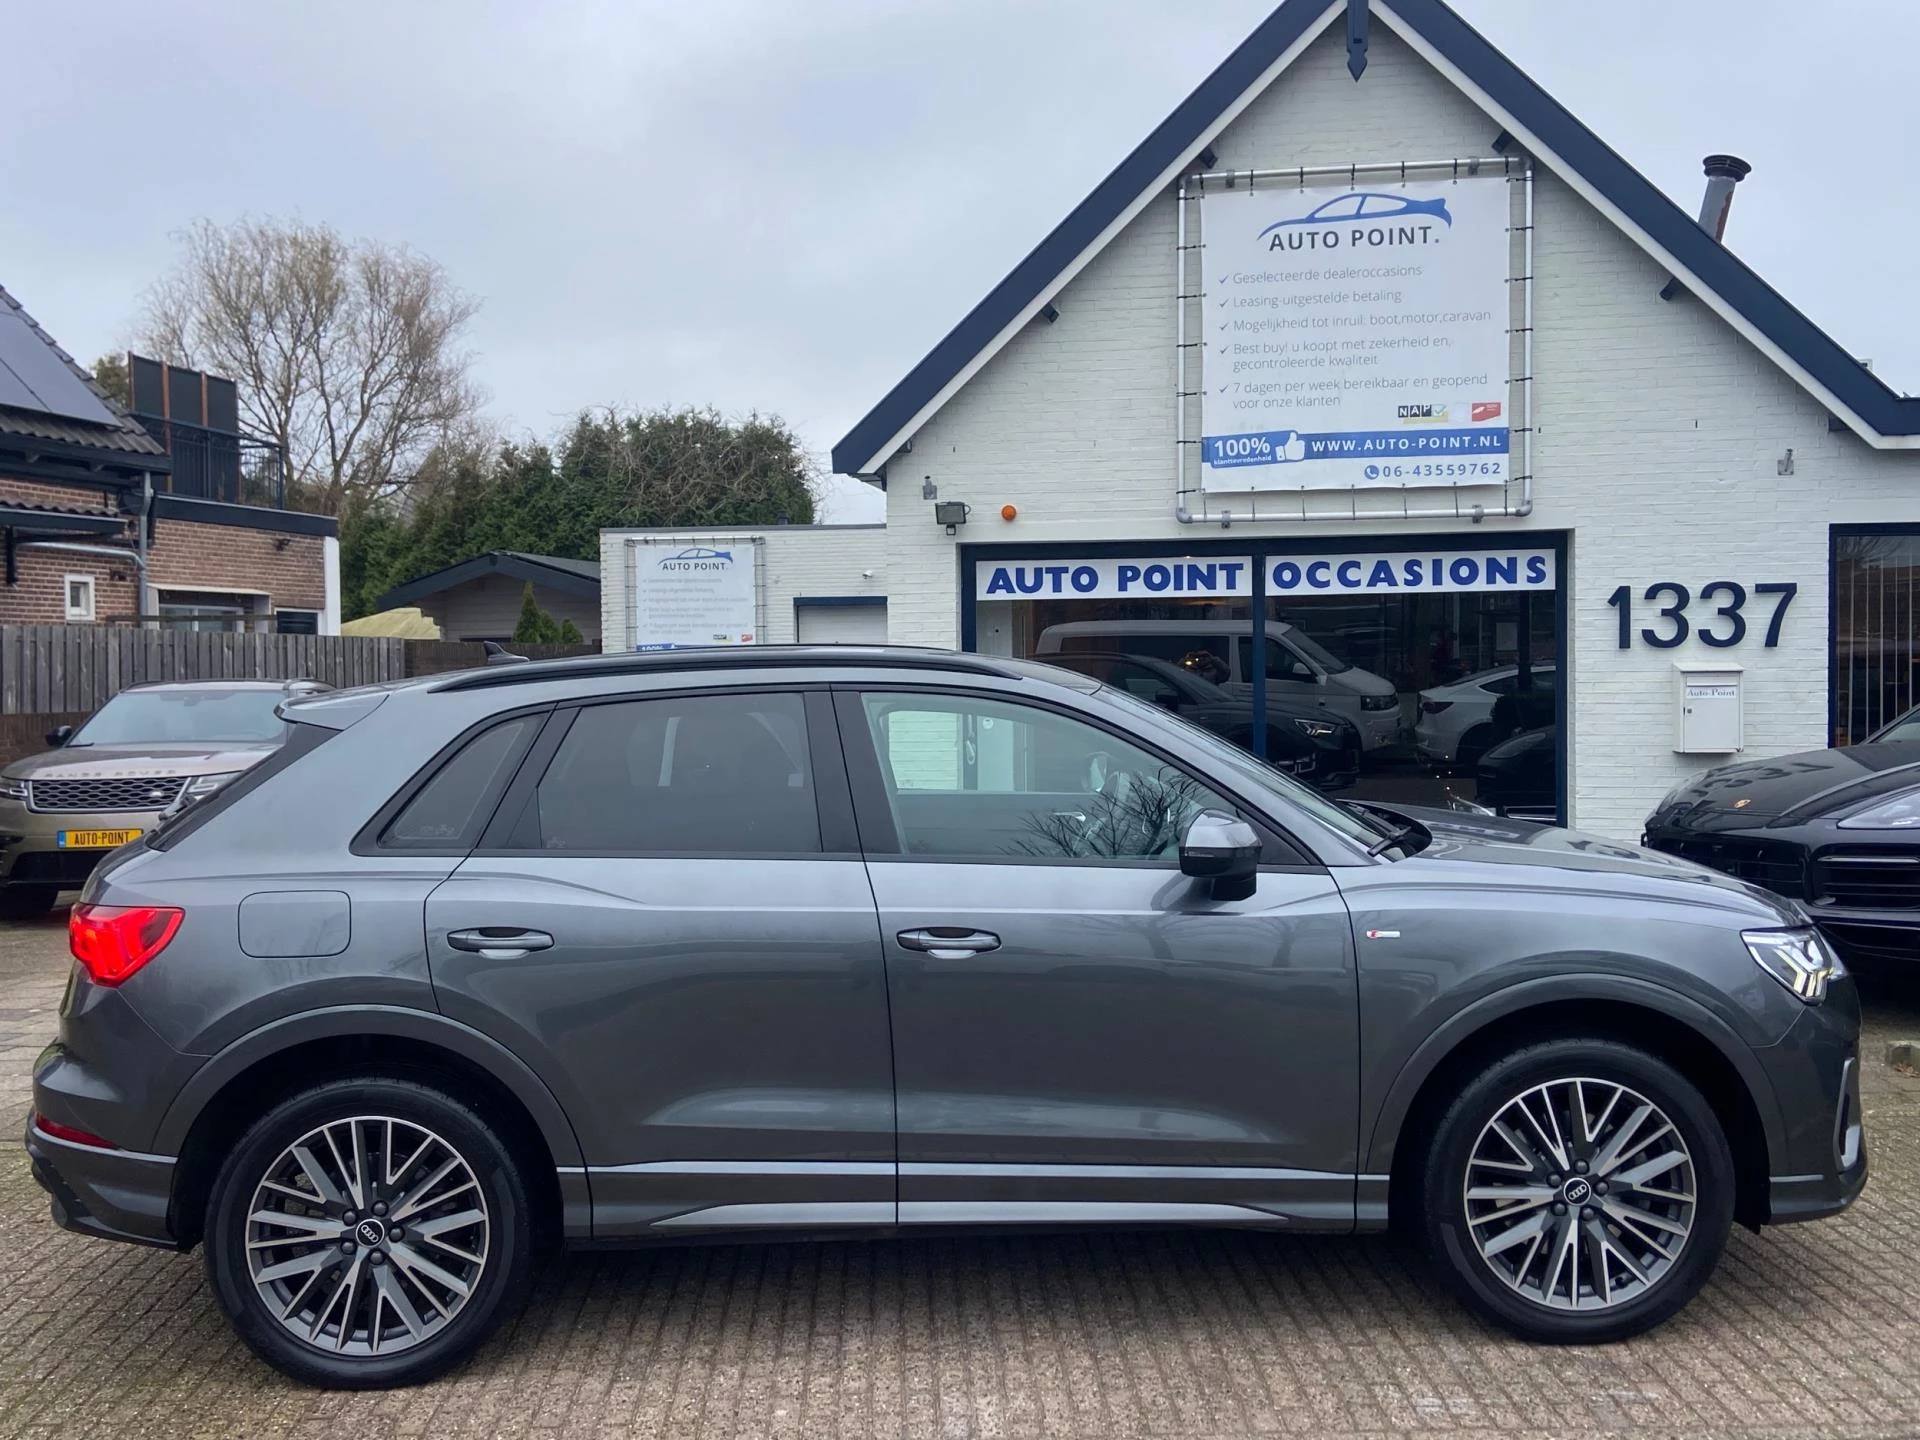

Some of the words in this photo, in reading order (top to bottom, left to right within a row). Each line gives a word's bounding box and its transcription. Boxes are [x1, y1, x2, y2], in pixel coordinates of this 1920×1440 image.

[1269, 230, 1340, 251] AUTO
[1233, 269, 1320, 284] Geselecteerde
[1323, 265, 1423, 280] dealeroccasions
[1353, 289, 1402, 304] betaling
[1233, 317, 1308, 333] Mogelijkheid
[1312, 318, 1328, 328] tot
[1233, 343, 1260, 354] Best
[1292, 344, 1300, 352] u
[1303, 340, 1338, 354] koopt
[1341, 339, 1365, 350] met
[1369, 336, 1429, 349] zekerheid
[1232, 356, 1325, 373] gecontroleerde
[1329, 354, 1378, 367] kwaliteit
[1233, 382, 1241, 393] 7
[1244, 382, 1281, 395] dagen
[1285, 382, 1304, 394] per
[1309, 379, 1340, 391] week
[1343, 377, 1409, 390] bereikbaar
[1413, 378, 1429, 388] en
[1432, 374, 1488, 390] geopend
[1233, 400, 1260, 409] voor
[1263, 399, 1293, 408] onze
[1296, 396, 1341, 408] klanten
[1397, 404, 1432, 418] NAP
[1214, 436, 1271, 457] 100%
[1311, 435, 1503, 452] WWW.AUTO-POINT.NL
[1382, 462, 1501, 478] 06-43559762
[662, 562, 691, 571] AUTO
[1272, 555, 1548, 590] OCCASIONS
[986, 564, 1099, 594] AUTO
[1117, 562, 1245, 592] POINT
[1607, 581, 1798, 649] 1337
